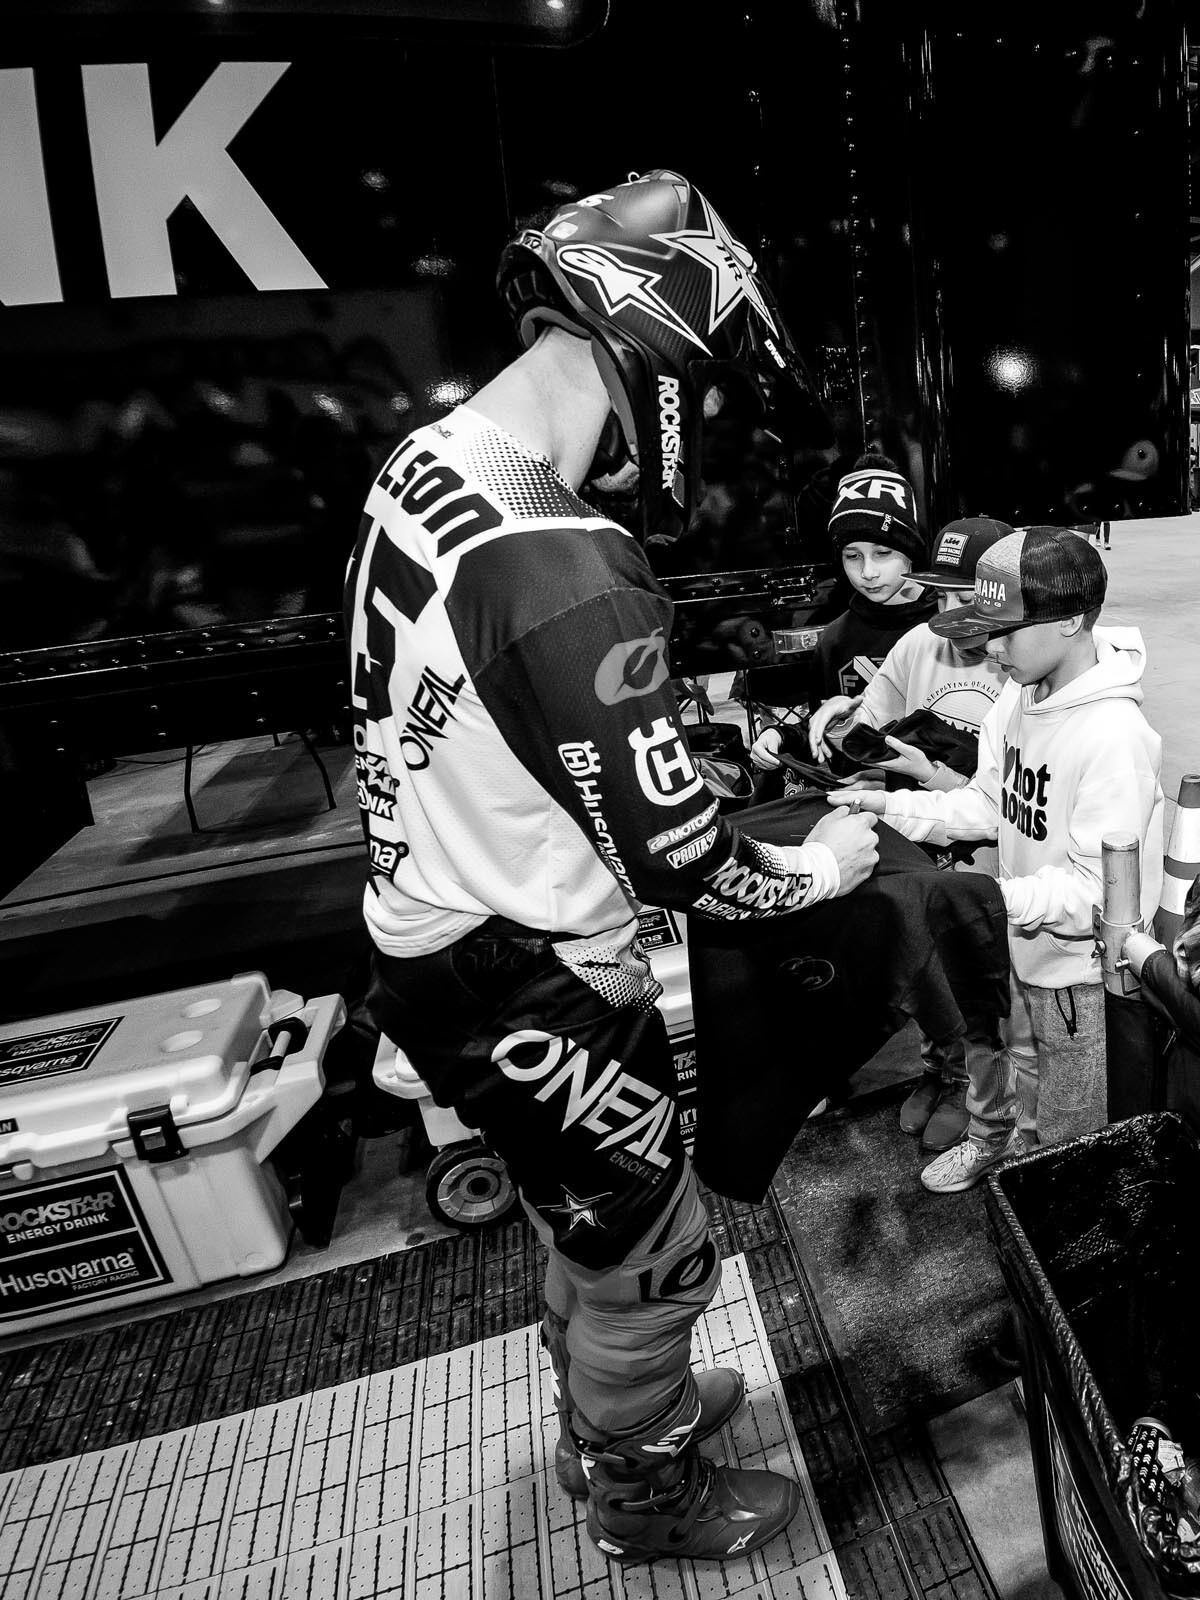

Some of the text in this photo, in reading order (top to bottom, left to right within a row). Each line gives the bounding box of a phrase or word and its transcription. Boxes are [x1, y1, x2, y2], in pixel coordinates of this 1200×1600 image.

[657, 374, 682, 490] ROCKSTAR
[376, 438, 504, 558] LSON
[832, 479, 907, 510] XR
[976, 577, 1006, 602] MAHA
[971, 681, 1000, 698] QUALIT
[0, 1054, 79, 1077] sqvarna
[6, 1212, 110, 1244] ENERGY DRINK
[0, 1251, 135, 1297] Husqvarna
[72, 1270, 140, 1291] FACTORY RACING
